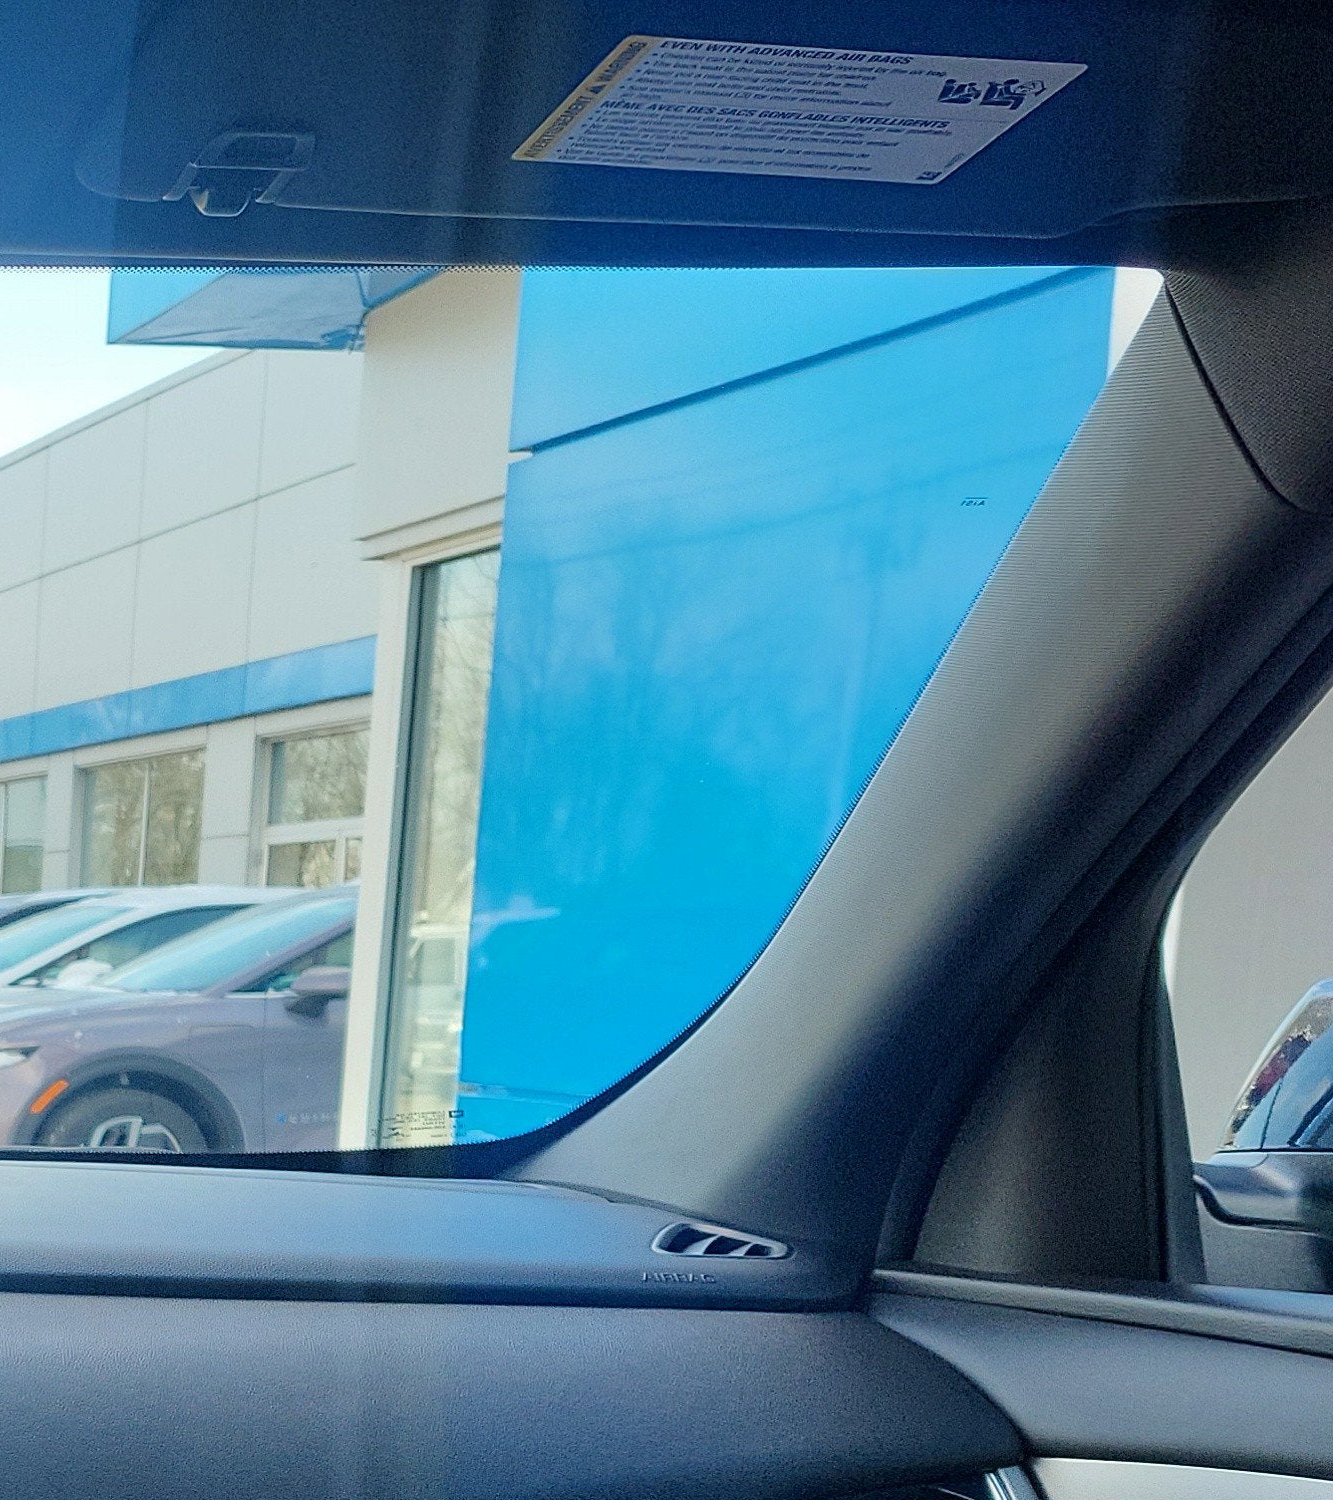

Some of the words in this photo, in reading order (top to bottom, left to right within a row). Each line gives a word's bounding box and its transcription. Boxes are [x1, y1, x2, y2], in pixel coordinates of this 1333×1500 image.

[660, 40, 703, 50] EVEN
[706, 43, 747, 54] WITH
[747, 46, 835, 59] ADVANCED
[836, 52, 867, 62] AIR
[867, 54, 914, 64] BAGS
[647, 102, 685, 113] AVEC
[687, 106, 717, 115] DES
[717, 108, 757, 118] SACS
[758, 111, 850, 122] GONFLABLES
[850, 116, 951, 129] INTELLIGENTS
